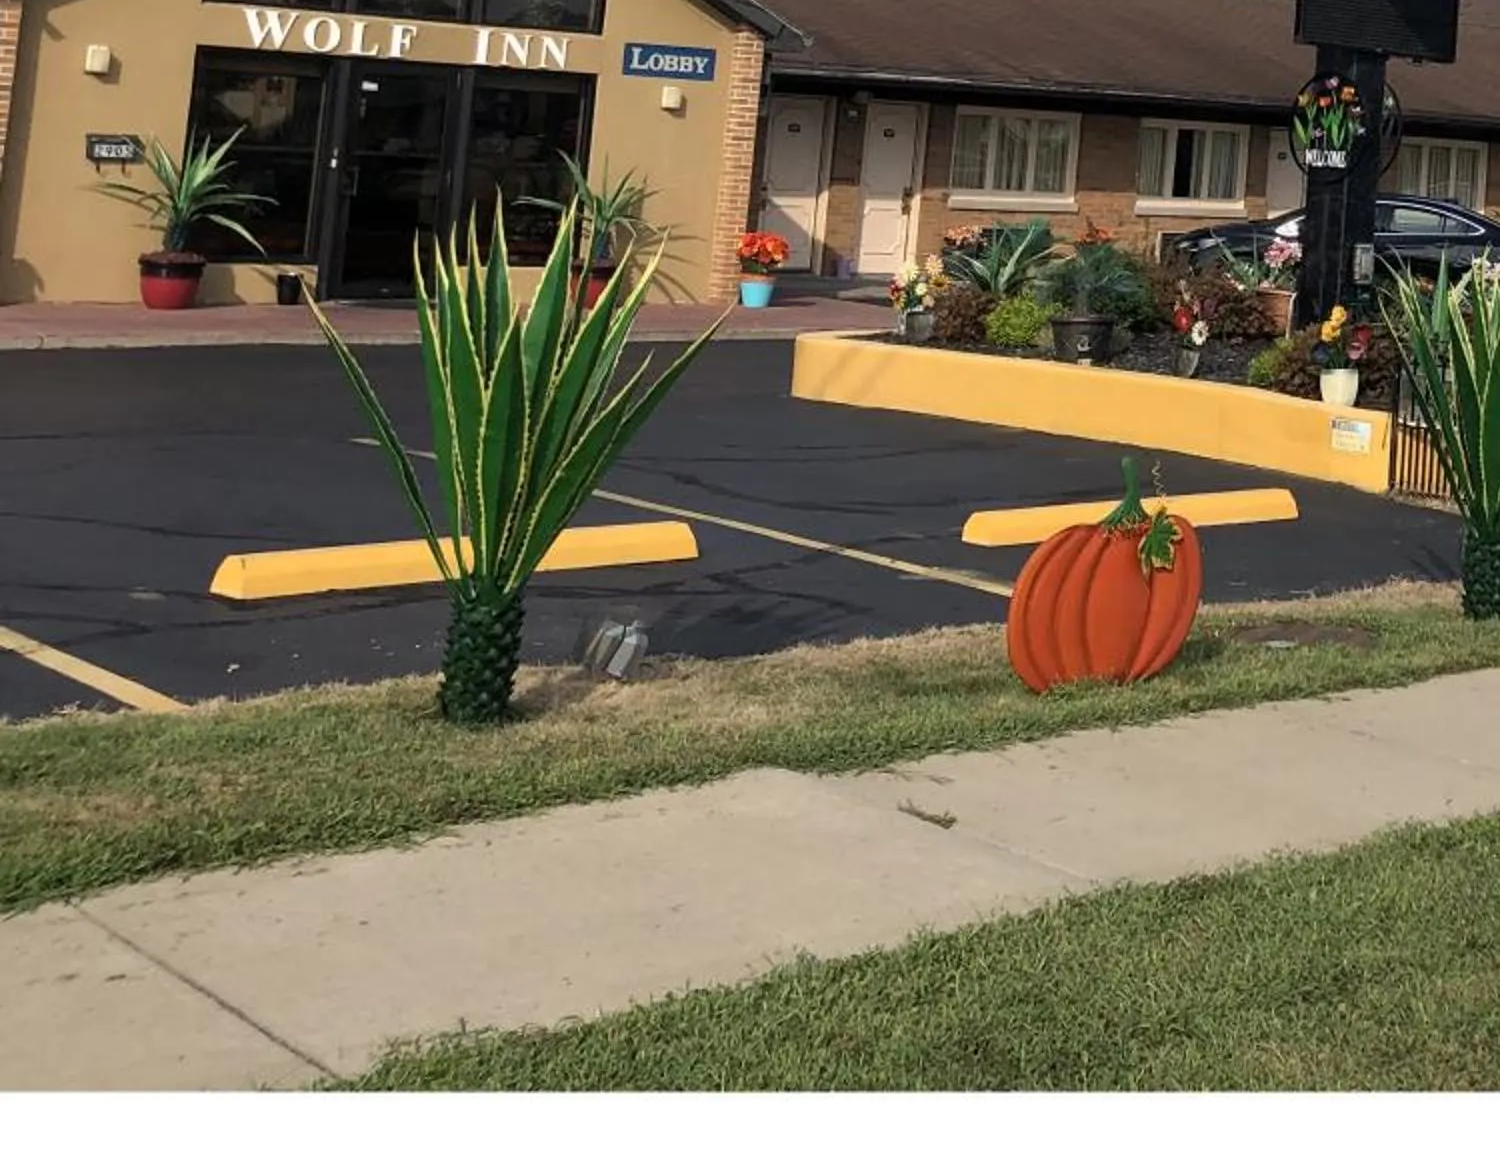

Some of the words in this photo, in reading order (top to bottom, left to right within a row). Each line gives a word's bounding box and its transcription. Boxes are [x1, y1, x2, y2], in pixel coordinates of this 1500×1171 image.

[243, 7, 418, 58] WOLF
[472, 27, 572, 70] INN
[629, 46, 709, 75] LOBBY
